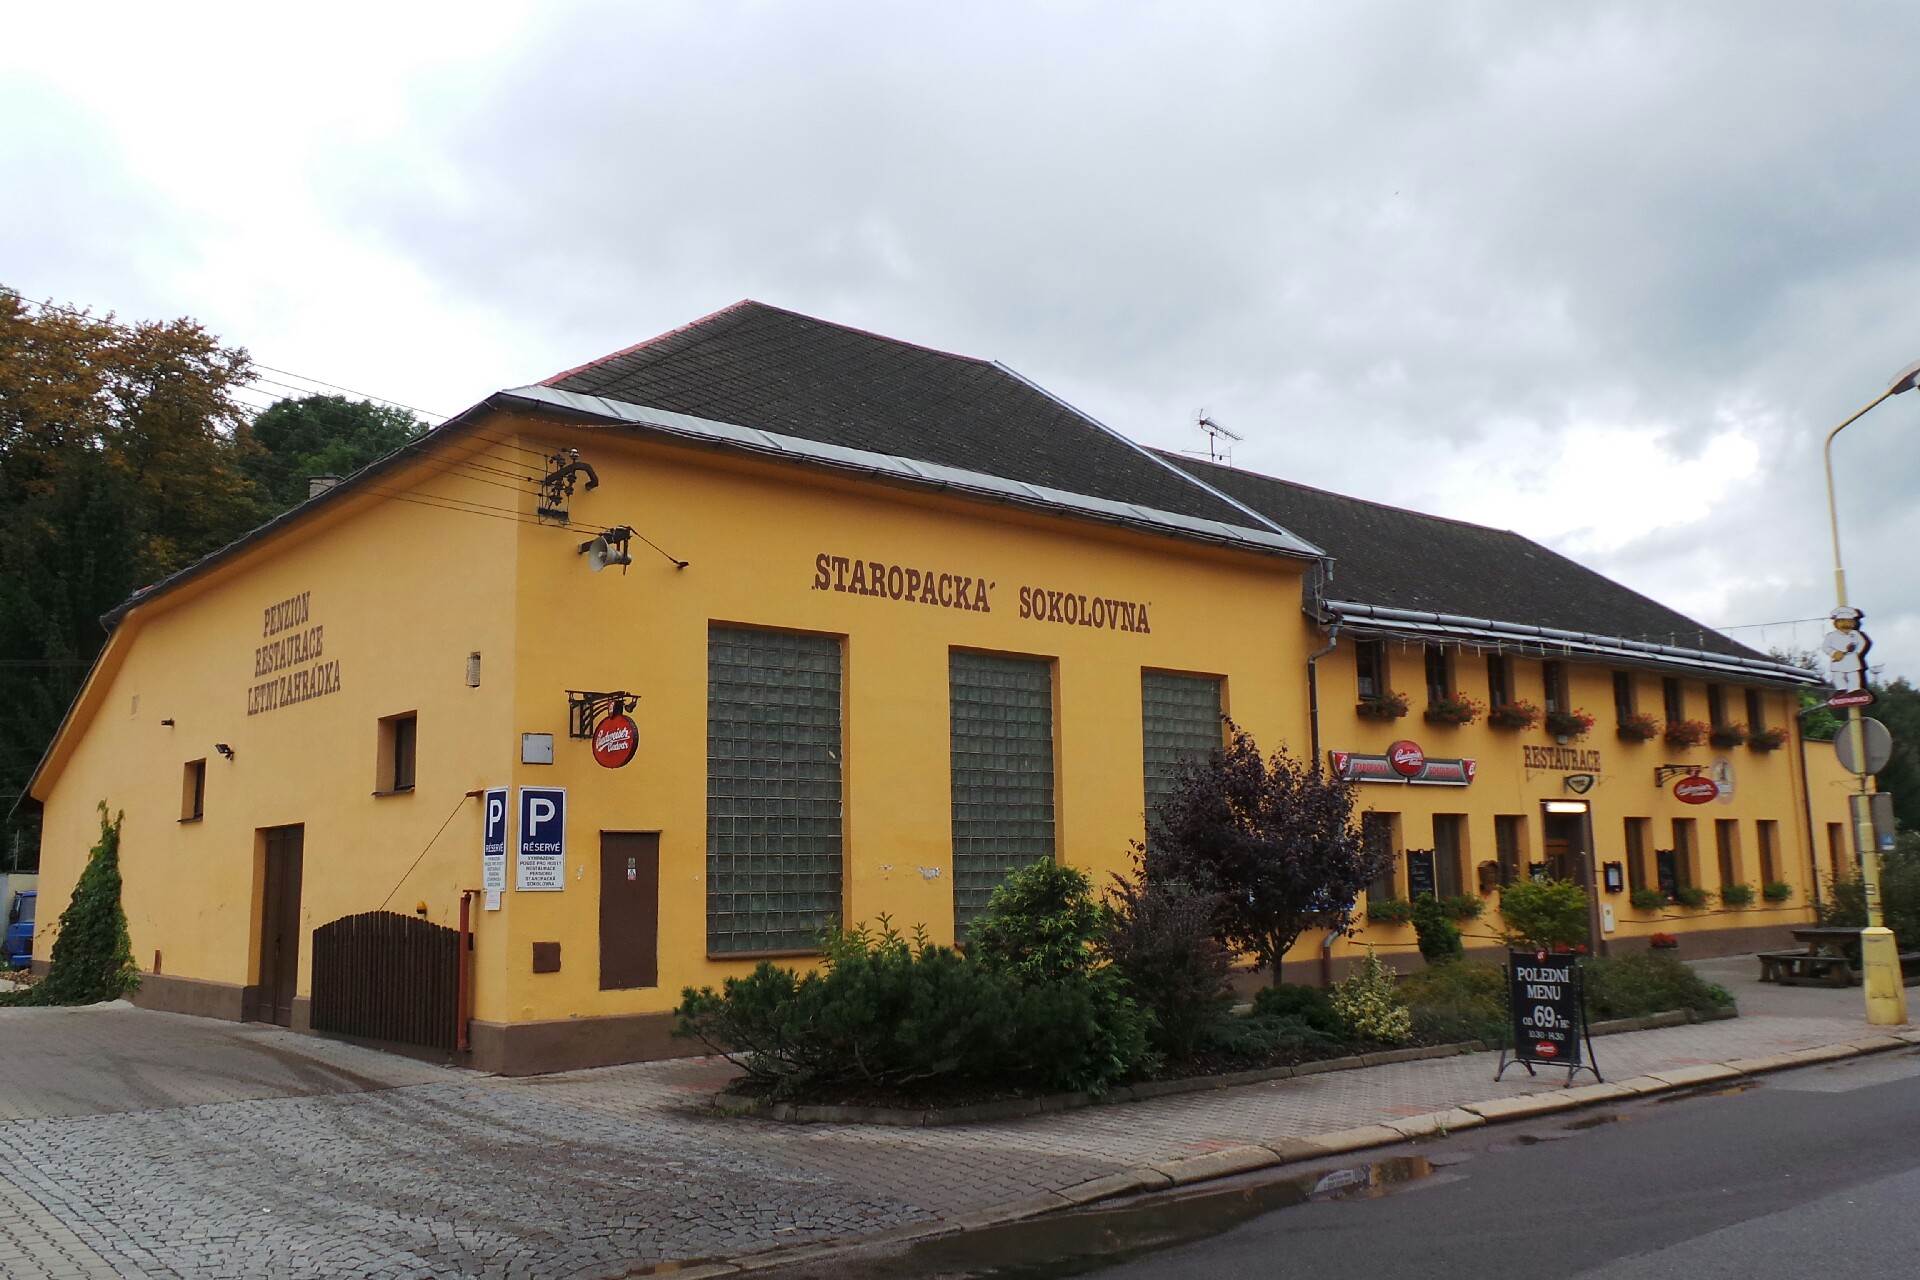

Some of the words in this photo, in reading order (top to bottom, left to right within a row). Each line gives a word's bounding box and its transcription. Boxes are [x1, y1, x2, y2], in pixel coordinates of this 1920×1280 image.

[264, 590, 311, 638] PENZION
[1019, 586, 1151, 634] SOKOLOVNA
[255, 625, 323, 677] RESTAURACE
[279, 659, 341, 707] ZAHRÁDKA
[1523, 745, 1601, 772] RESTAURACE
[488, 799, 503, 838] P
[529, 798, 556, 837] P
[523, 841, 561, 852] RÉSERVÉ
[1516, 965, 1569, 983] POLEDNÍ
[1526, 984, 1561, 1001] MENU
